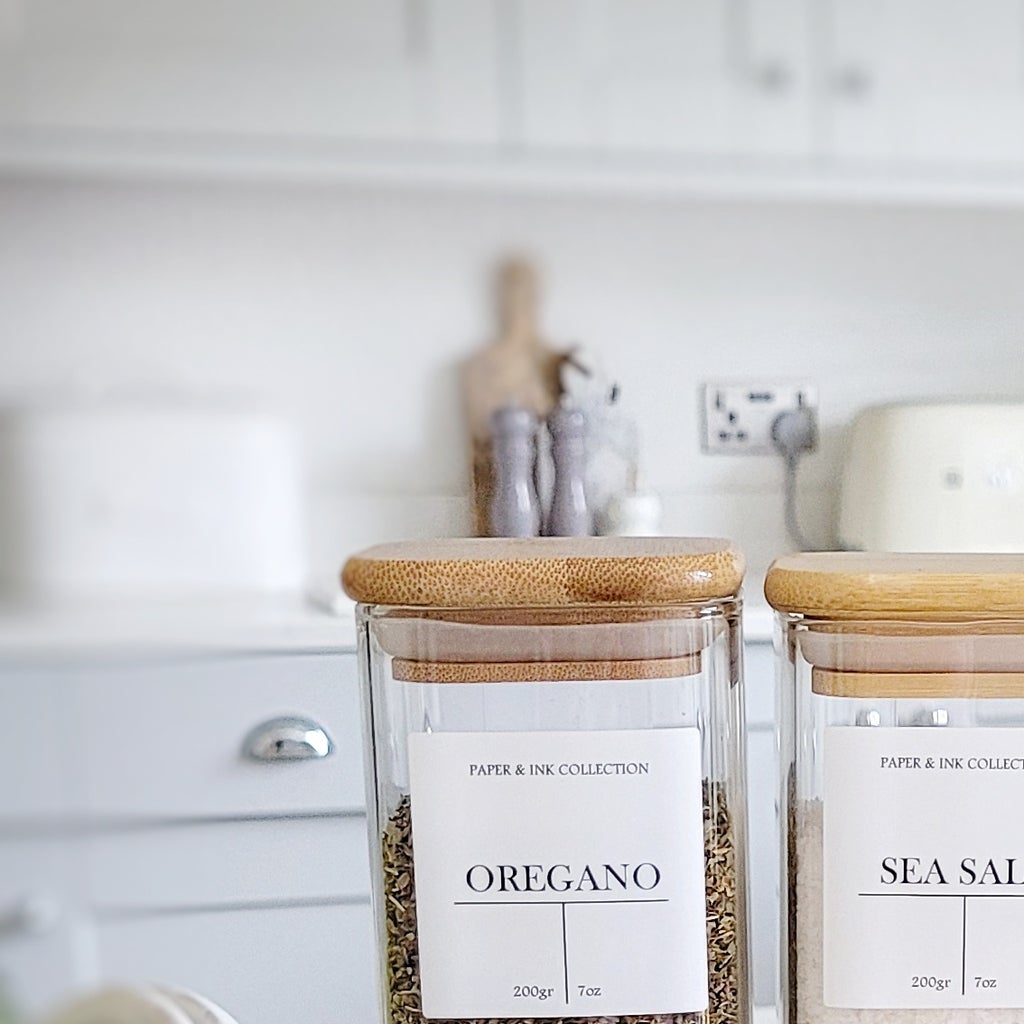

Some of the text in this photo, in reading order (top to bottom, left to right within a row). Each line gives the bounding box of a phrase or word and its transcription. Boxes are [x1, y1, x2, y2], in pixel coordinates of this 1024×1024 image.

[469, 763, 649, 776] PAPER & INK COLLECTION
[880, 757, 921, 769] PAPER
[925, 757, 935, 769] &
[939, 758, 963, 769] INK
[465, 862, 661, 892] OREGANO
[880, 856, 950, 885] SEA
[911, 976, 997, 991] 200gr 7oz
[513, 985, 602, 1001] 200gr 7oz
